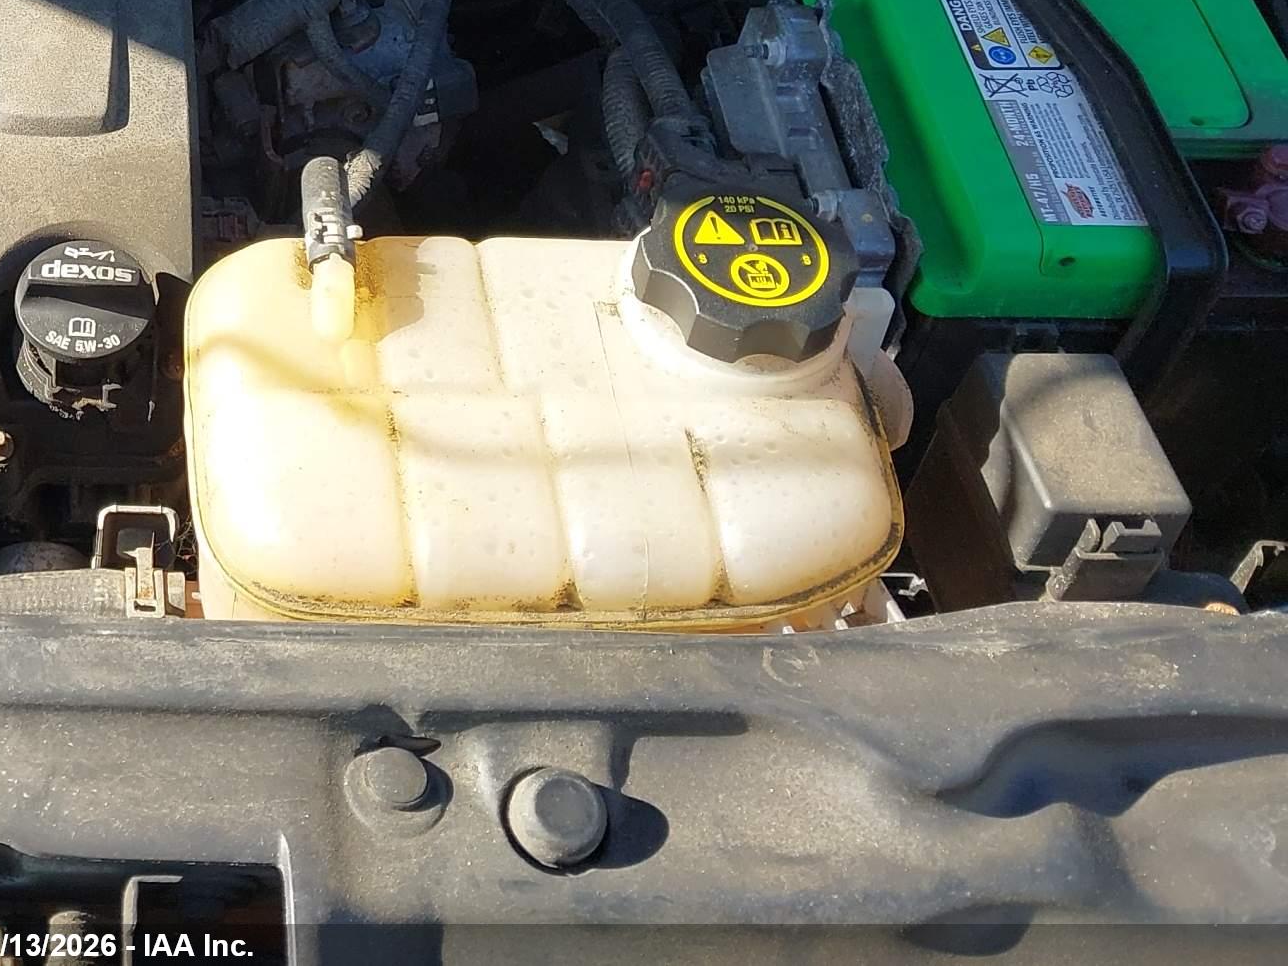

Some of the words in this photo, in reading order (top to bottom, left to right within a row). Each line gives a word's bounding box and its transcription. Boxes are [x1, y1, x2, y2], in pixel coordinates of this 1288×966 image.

[1023, 78, 1039, 91] Pb
[996, 100, 1030, 146] 24-MONTH
[718, 196, 735, 205] 140
[737, 196, 756, 205] kPa
[724, 205, 737, 213] 20
[738, 205, 755, 213] PSI
[41, 260, 136, 283] dexos
[45, 330, 71, 350] SAE
[75, 334, 121, 353] 5W-30
